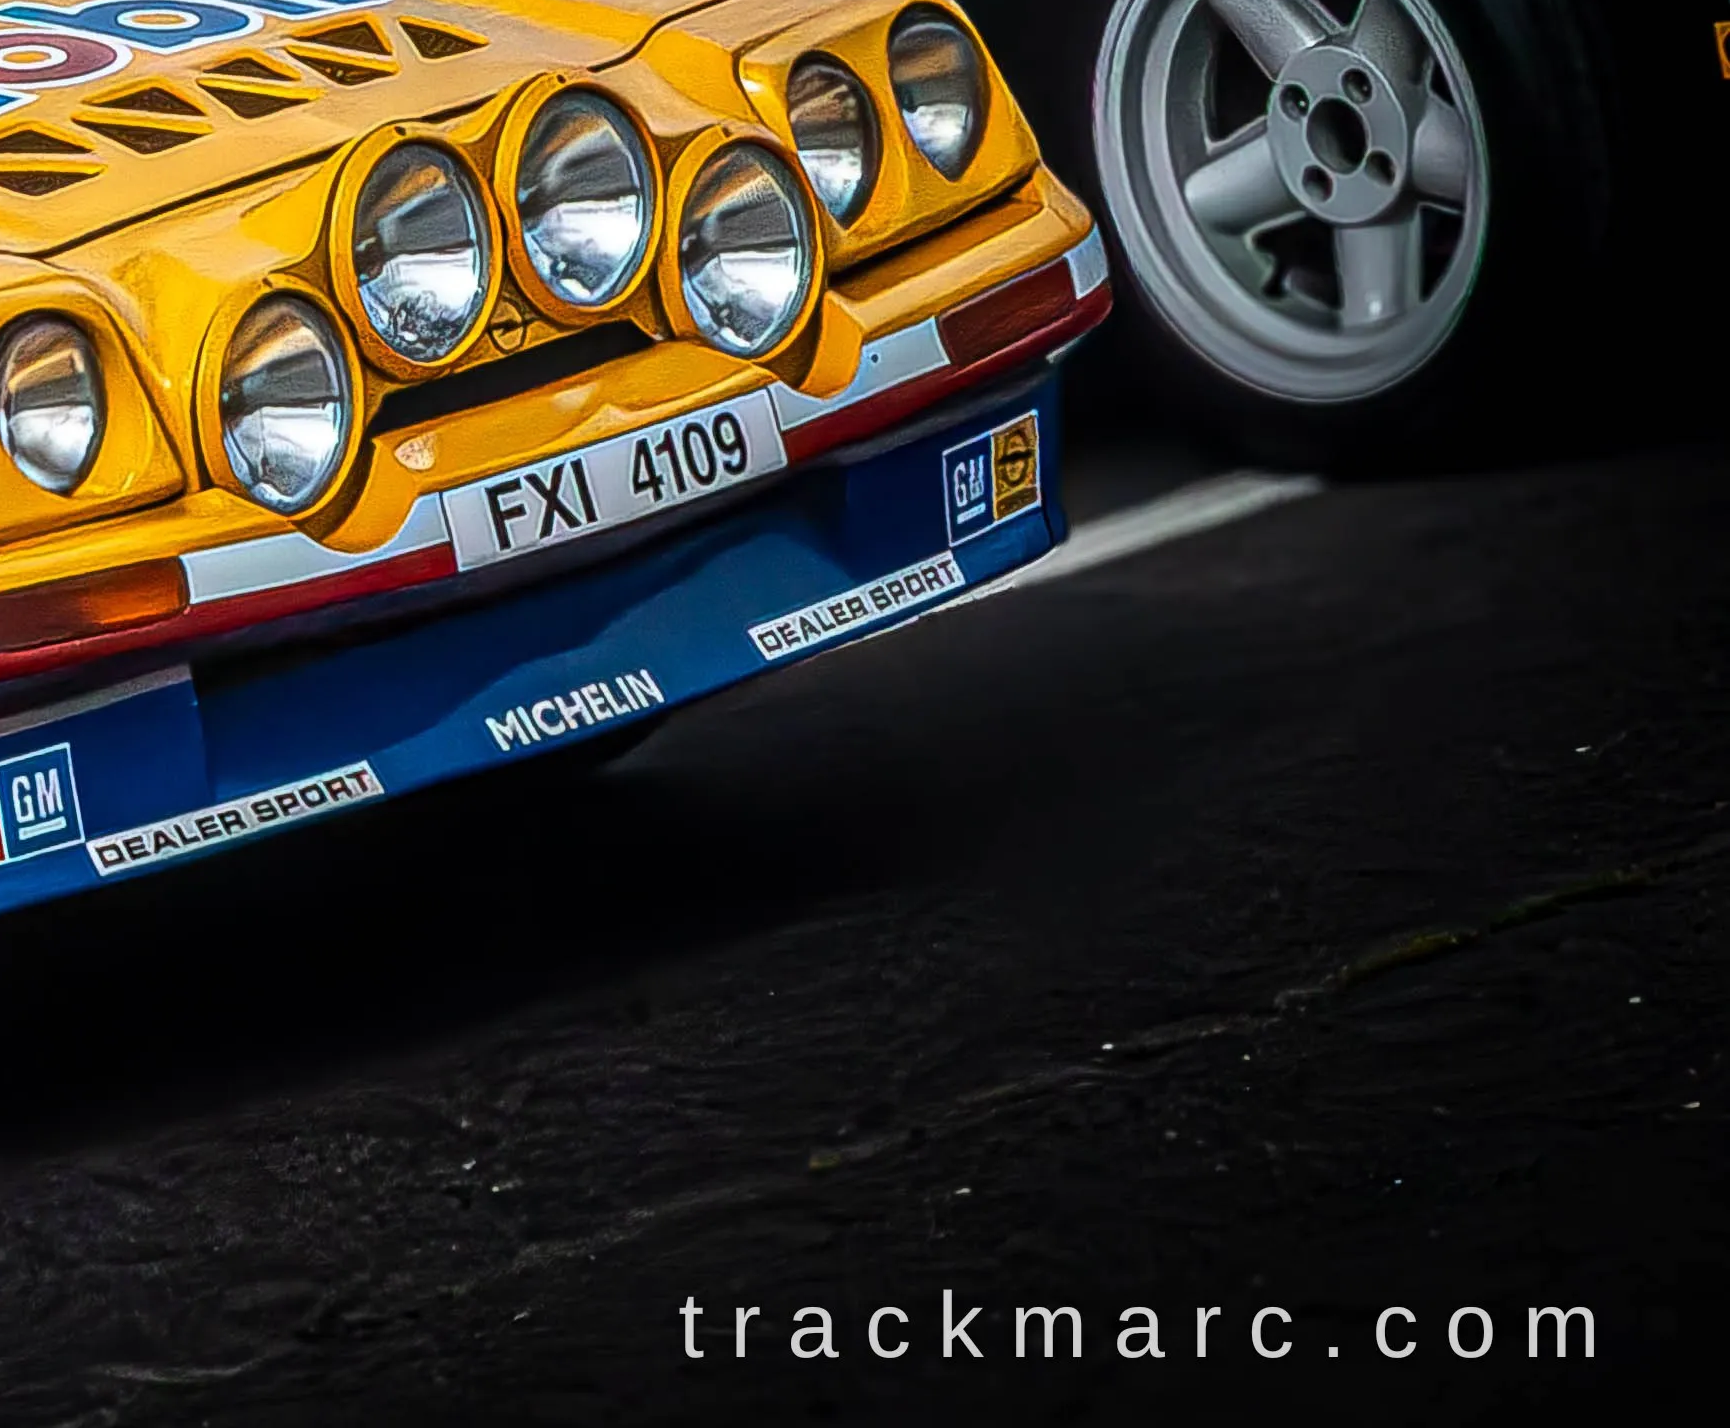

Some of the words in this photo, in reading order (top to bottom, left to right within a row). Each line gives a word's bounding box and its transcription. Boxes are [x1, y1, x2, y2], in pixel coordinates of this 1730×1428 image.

[483, 458, 598, 552] FXI
[629, 410, 750, 504] 4109
[757, 596, 869, 653] DEALER
[868, 559, 956, 611] SPORT
[484, 669, 666, 752] MICHELIN
[11, 768, 64, 822] GM
[95, 810, 247, 868] DEALER
[251, 770, 372, 823] SPORT
